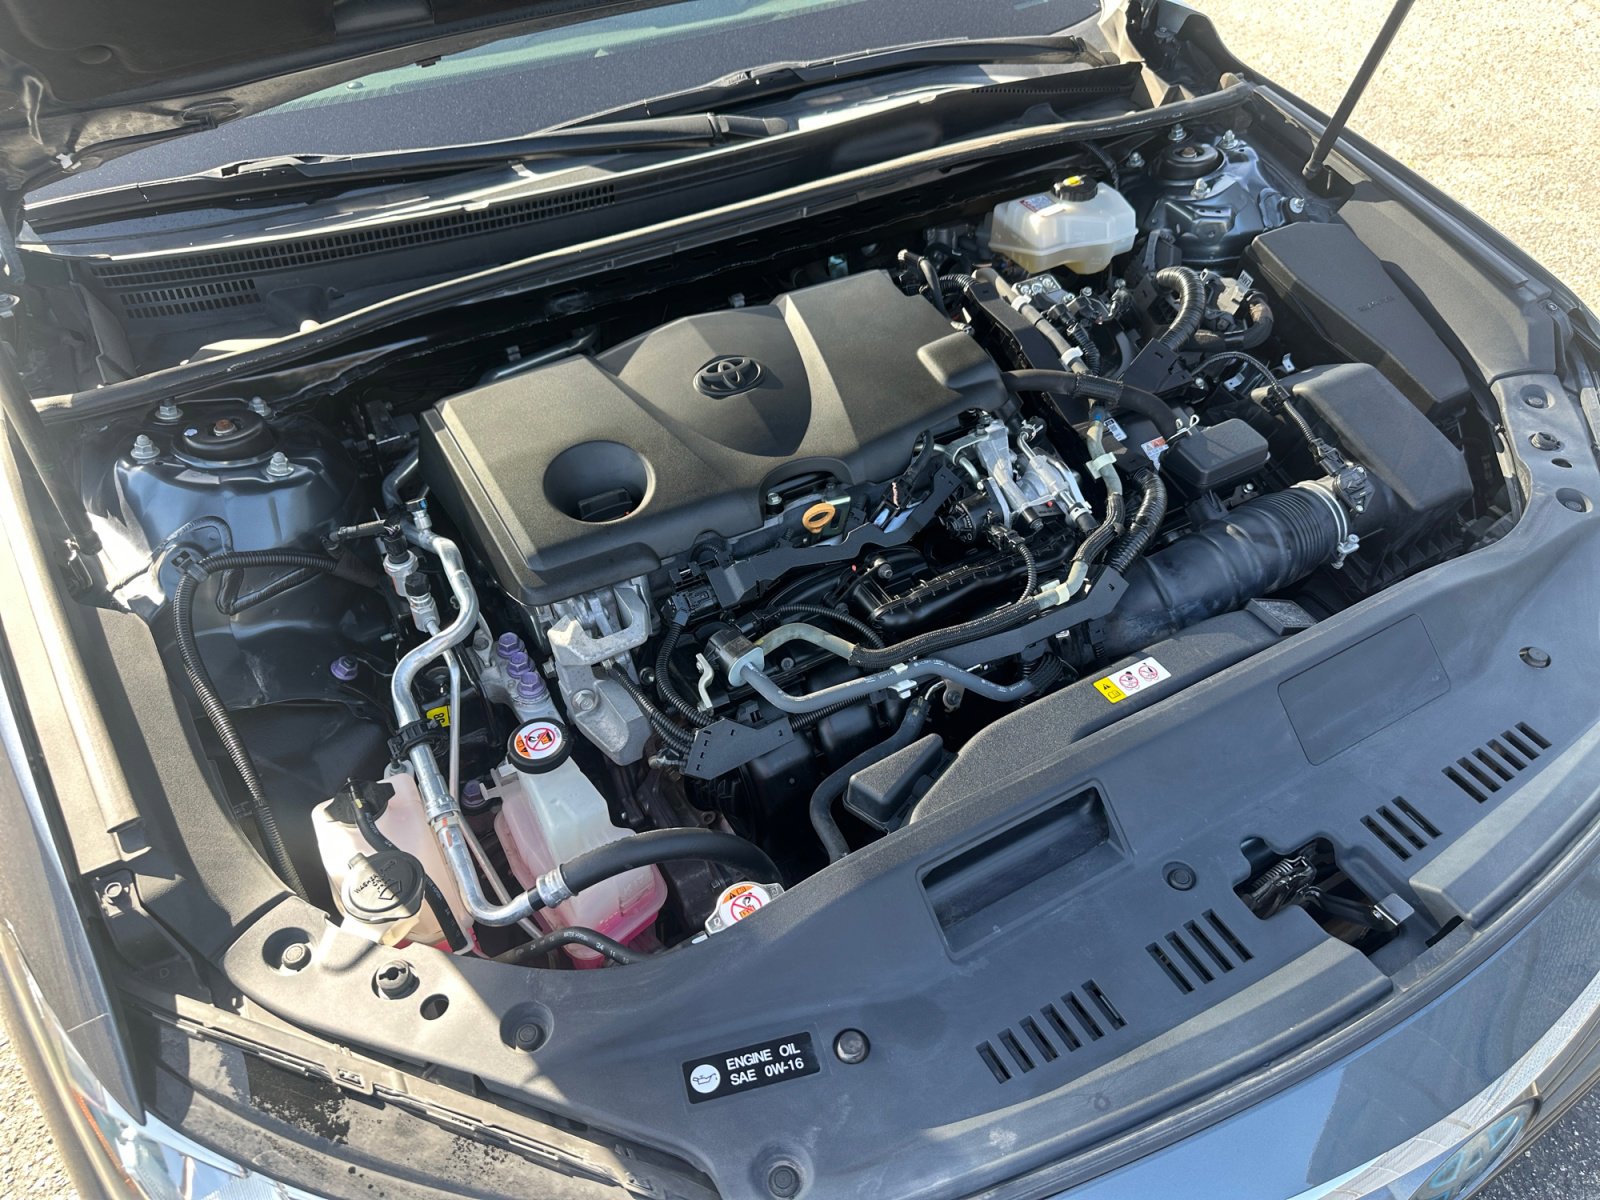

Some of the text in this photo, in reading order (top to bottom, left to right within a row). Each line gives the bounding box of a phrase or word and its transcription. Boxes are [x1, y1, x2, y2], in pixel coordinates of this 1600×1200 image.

[726, 1042, 801, 1070] ENGINE OIL
[730, 1057, 805, 1085] SAE 0W-16
